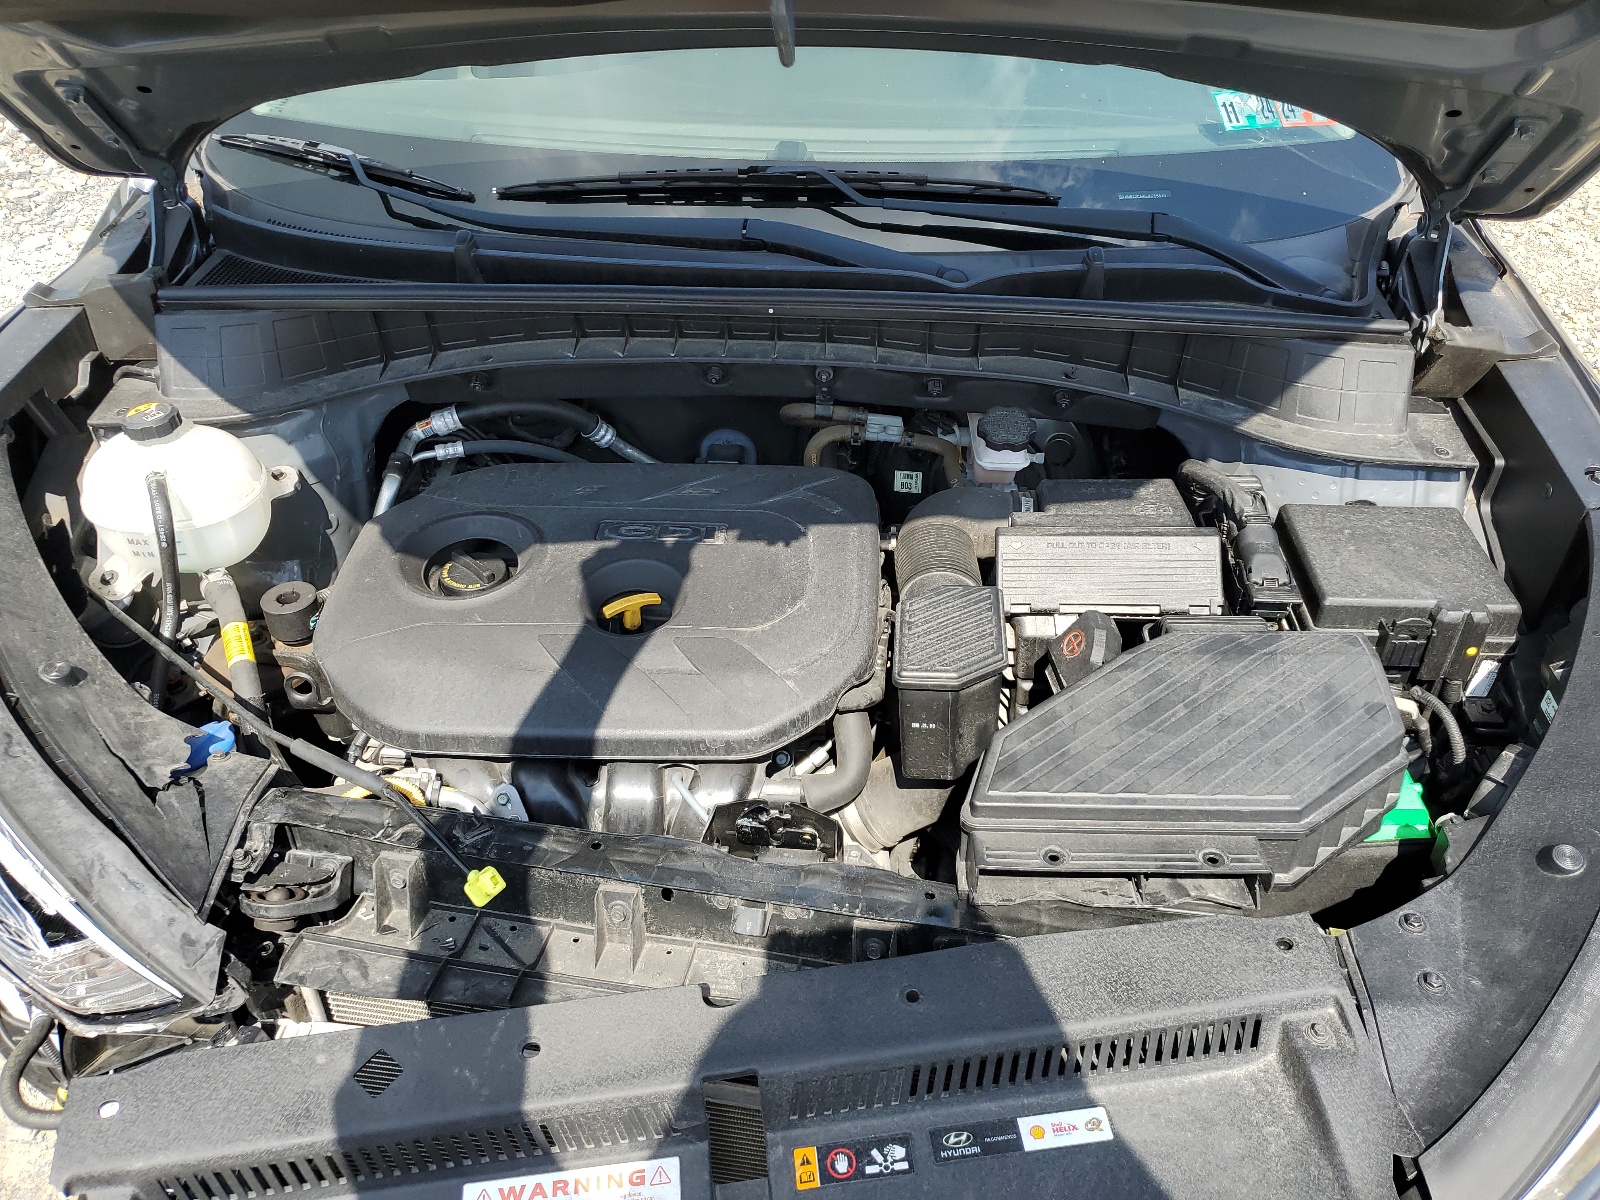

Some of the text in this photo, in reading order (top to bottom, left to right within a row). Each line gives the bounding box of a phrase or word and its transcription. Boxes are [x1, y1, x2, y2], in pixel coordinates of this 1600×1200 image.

[1221, 101, 1240, 124] 11
[604, 525, 717, 542] GDI
[127, 537, 149, 546] MAX
[132, 550, 155, 558] MIN
[1052, 1124, 1079, 1134] HELIX
[940, 1145, 981, 1158] HYUNDAI
[498, 1169, 646, 1200] WARNING
